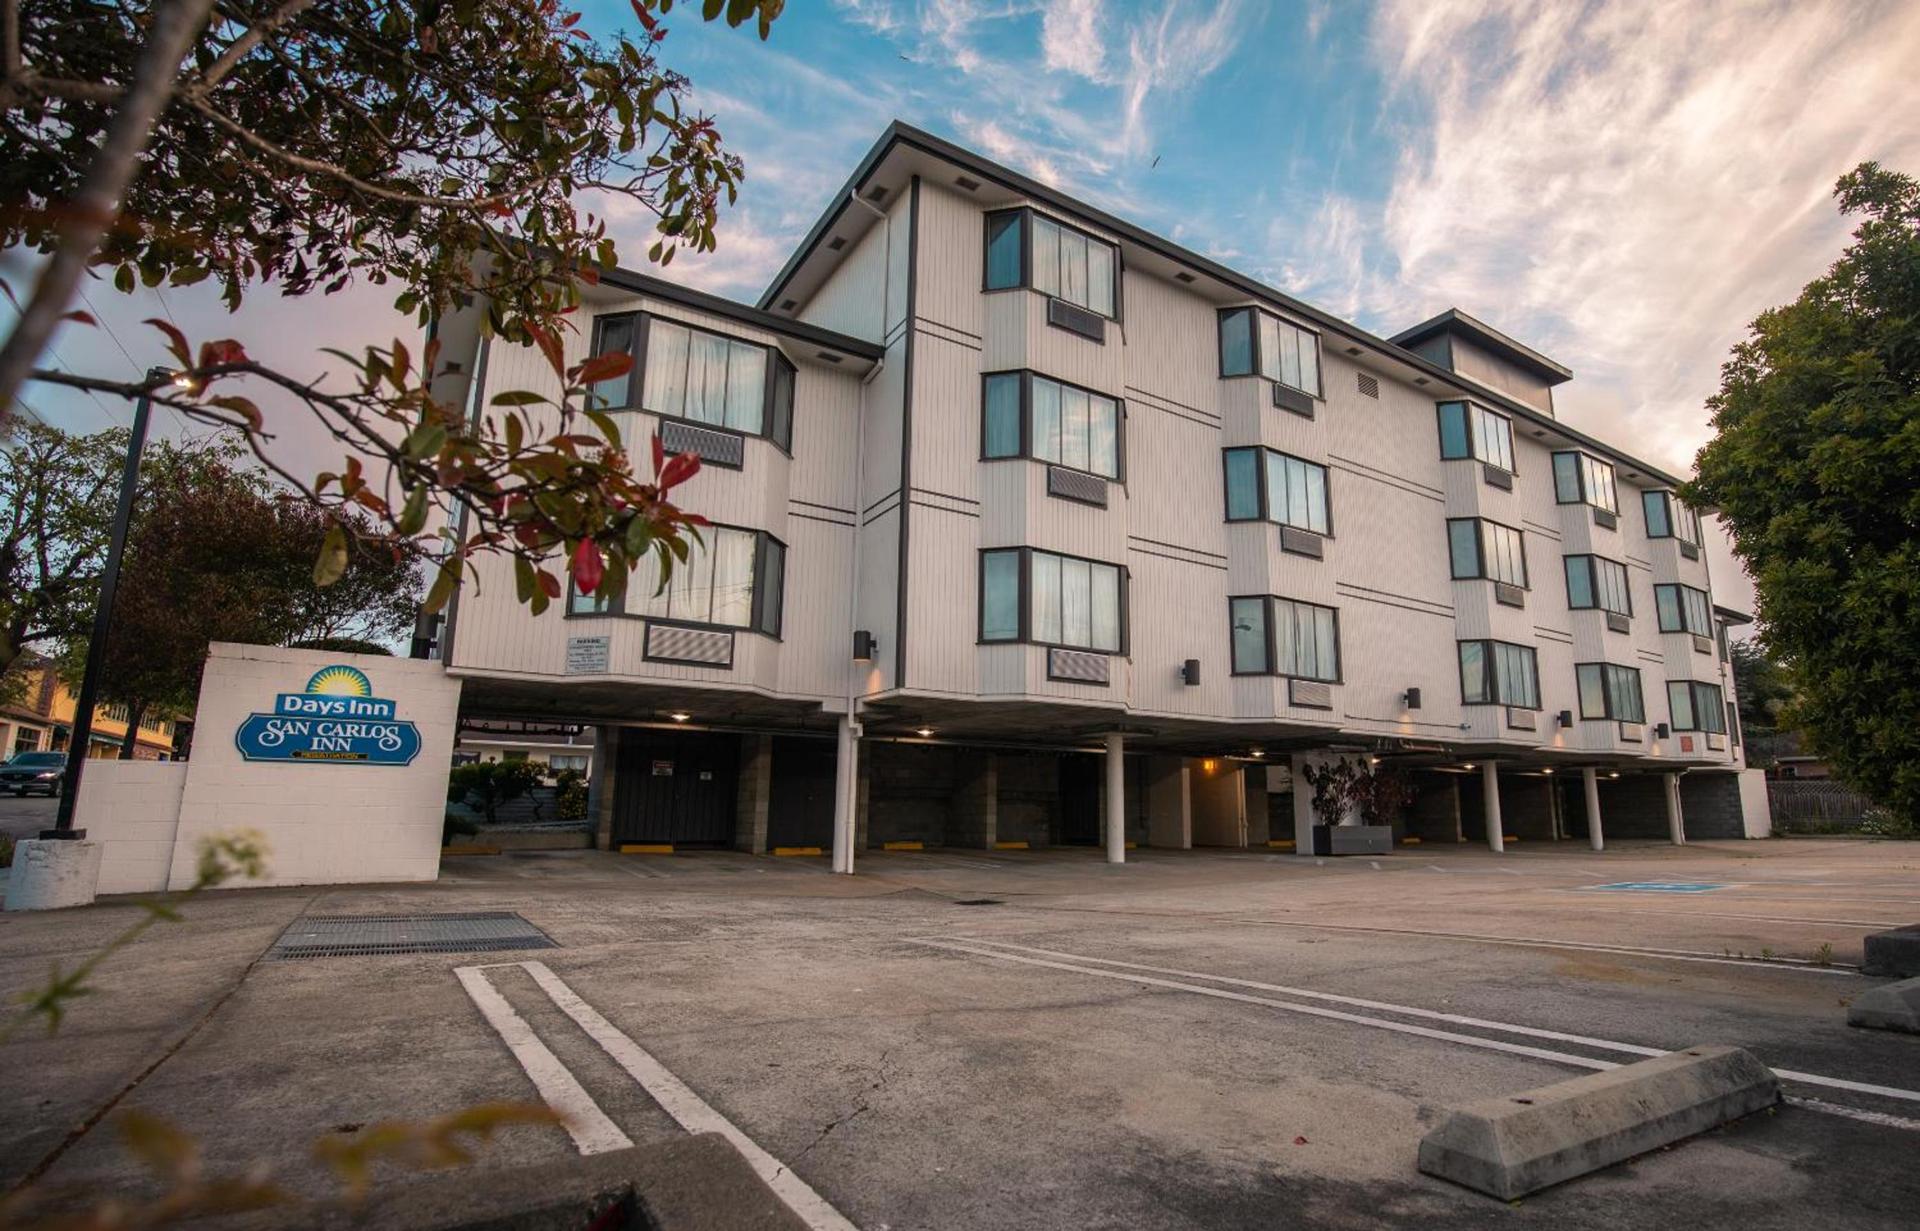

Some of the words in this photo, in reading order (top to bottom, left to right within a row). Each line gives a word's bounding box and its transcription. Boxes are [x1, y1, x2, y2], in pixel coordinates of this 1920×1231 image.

[284, 695, 345, 716] Days
[349, 699, 390, 717] Inn
[258, 719, 311, 747] SAN
[316, 722, 402, 751] CARLOS
[310, 737, 352, 752] INN
